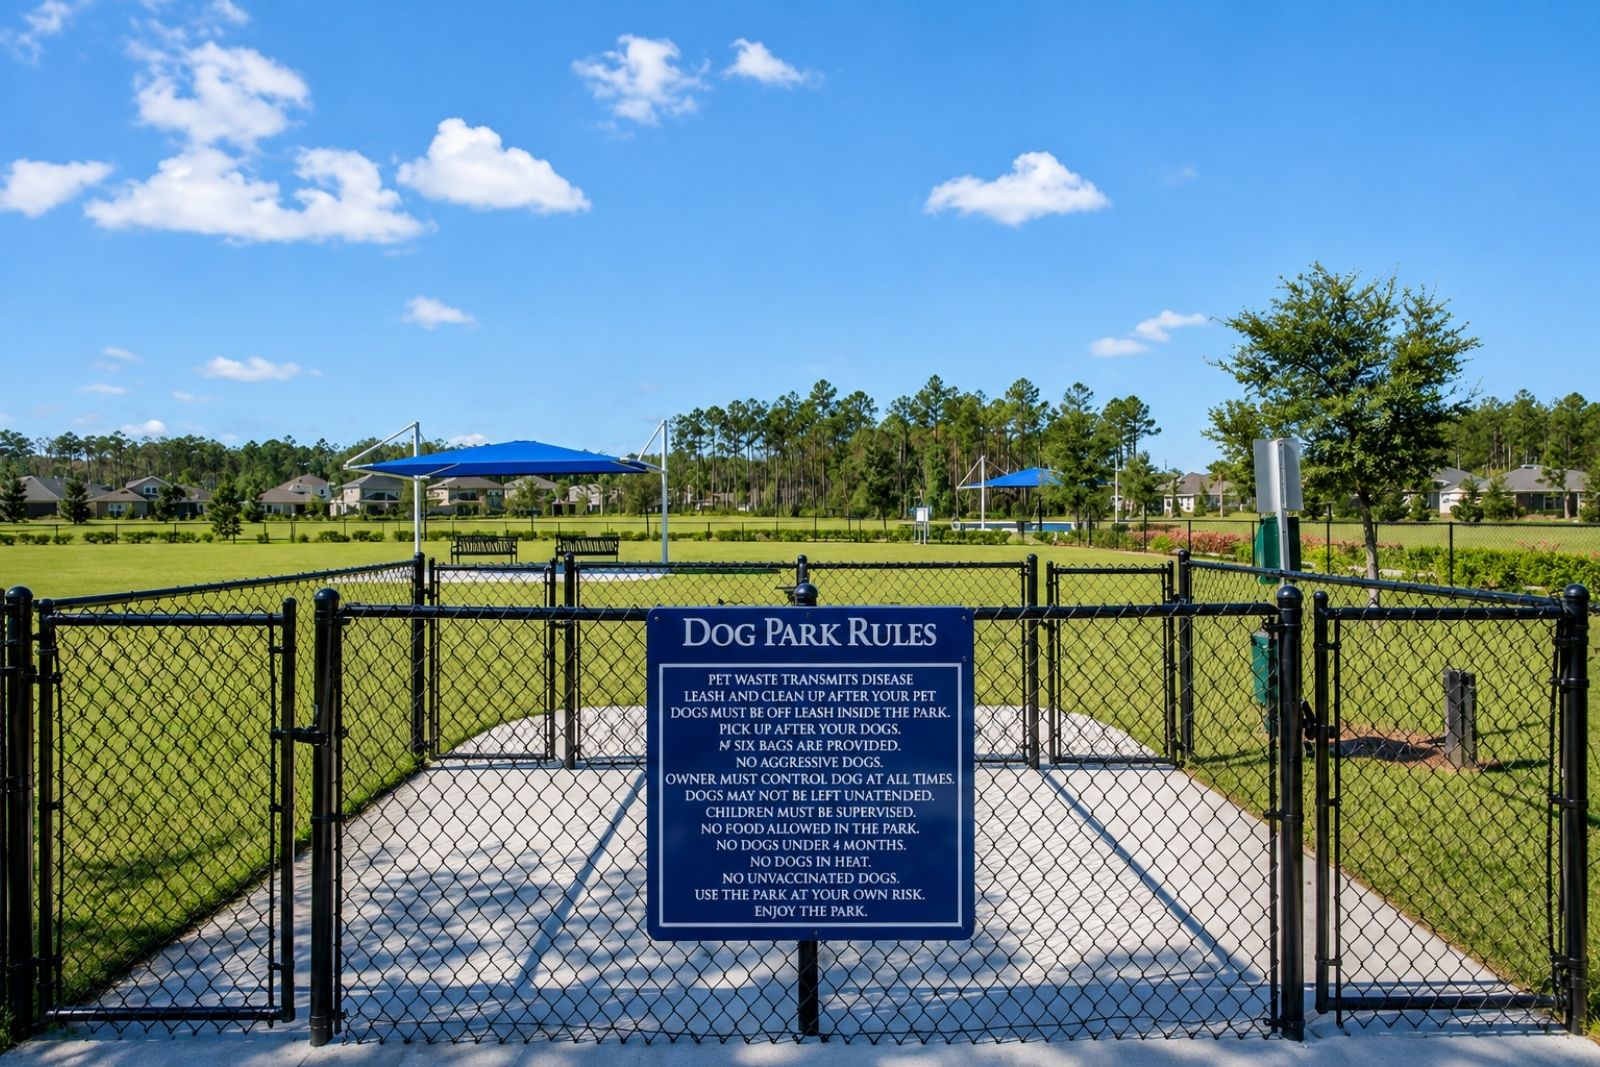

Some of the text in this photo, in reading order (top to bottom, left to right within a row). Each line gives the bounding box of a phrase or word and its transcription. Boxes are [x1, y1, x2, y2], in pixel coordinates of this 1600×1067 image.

[708, 673, 914, 686] PET WASTE TRANSMITS DISEASE
[684, 690, 937, 702] LEASH AND CLEAN UP AFTER YOUR PET
[670, 706, 951, 719] DOGS MUST BE OFF LEASH INSIDE THE PARK.
[719, 723, 901, 735] PICK UP AFTER YOUR DOGS.
[734, 739, 756, 752] SIX
[759, 739, 793, 752] BAGS
[796, 739, 823, 752] ARE
[826, 739, 901, 751] PROVIDED.
[736, 756, 884, 769] NO AGGRESSIVE DOGS.
[665, 773, 955, 785] OWNER MUST CONTROL DOG AT ALL TIMES.
[685, 789, 935, 802] DOGS MAY NOT BE LEFT UNATENDED.
[705, 806, 917, 818] CHILDREN MUST BE SUPERVISED.
[701, 822, 920, 835] NO FOOD ALLOWED IN THE PARK.
[716, 839, 907, 851] NO DOGS UNDER 4 MONTHS.
[750, 855, 872, 868] NO DOGS IN HEAT.
[722, 872, 900, 885] NO UNVACCINATED DOGS.
[695, 888, 926, 901] USE THE PARK AT YOUR OWN RISK.
[754, 905, 868, 920] ENJOY THE PARK.
